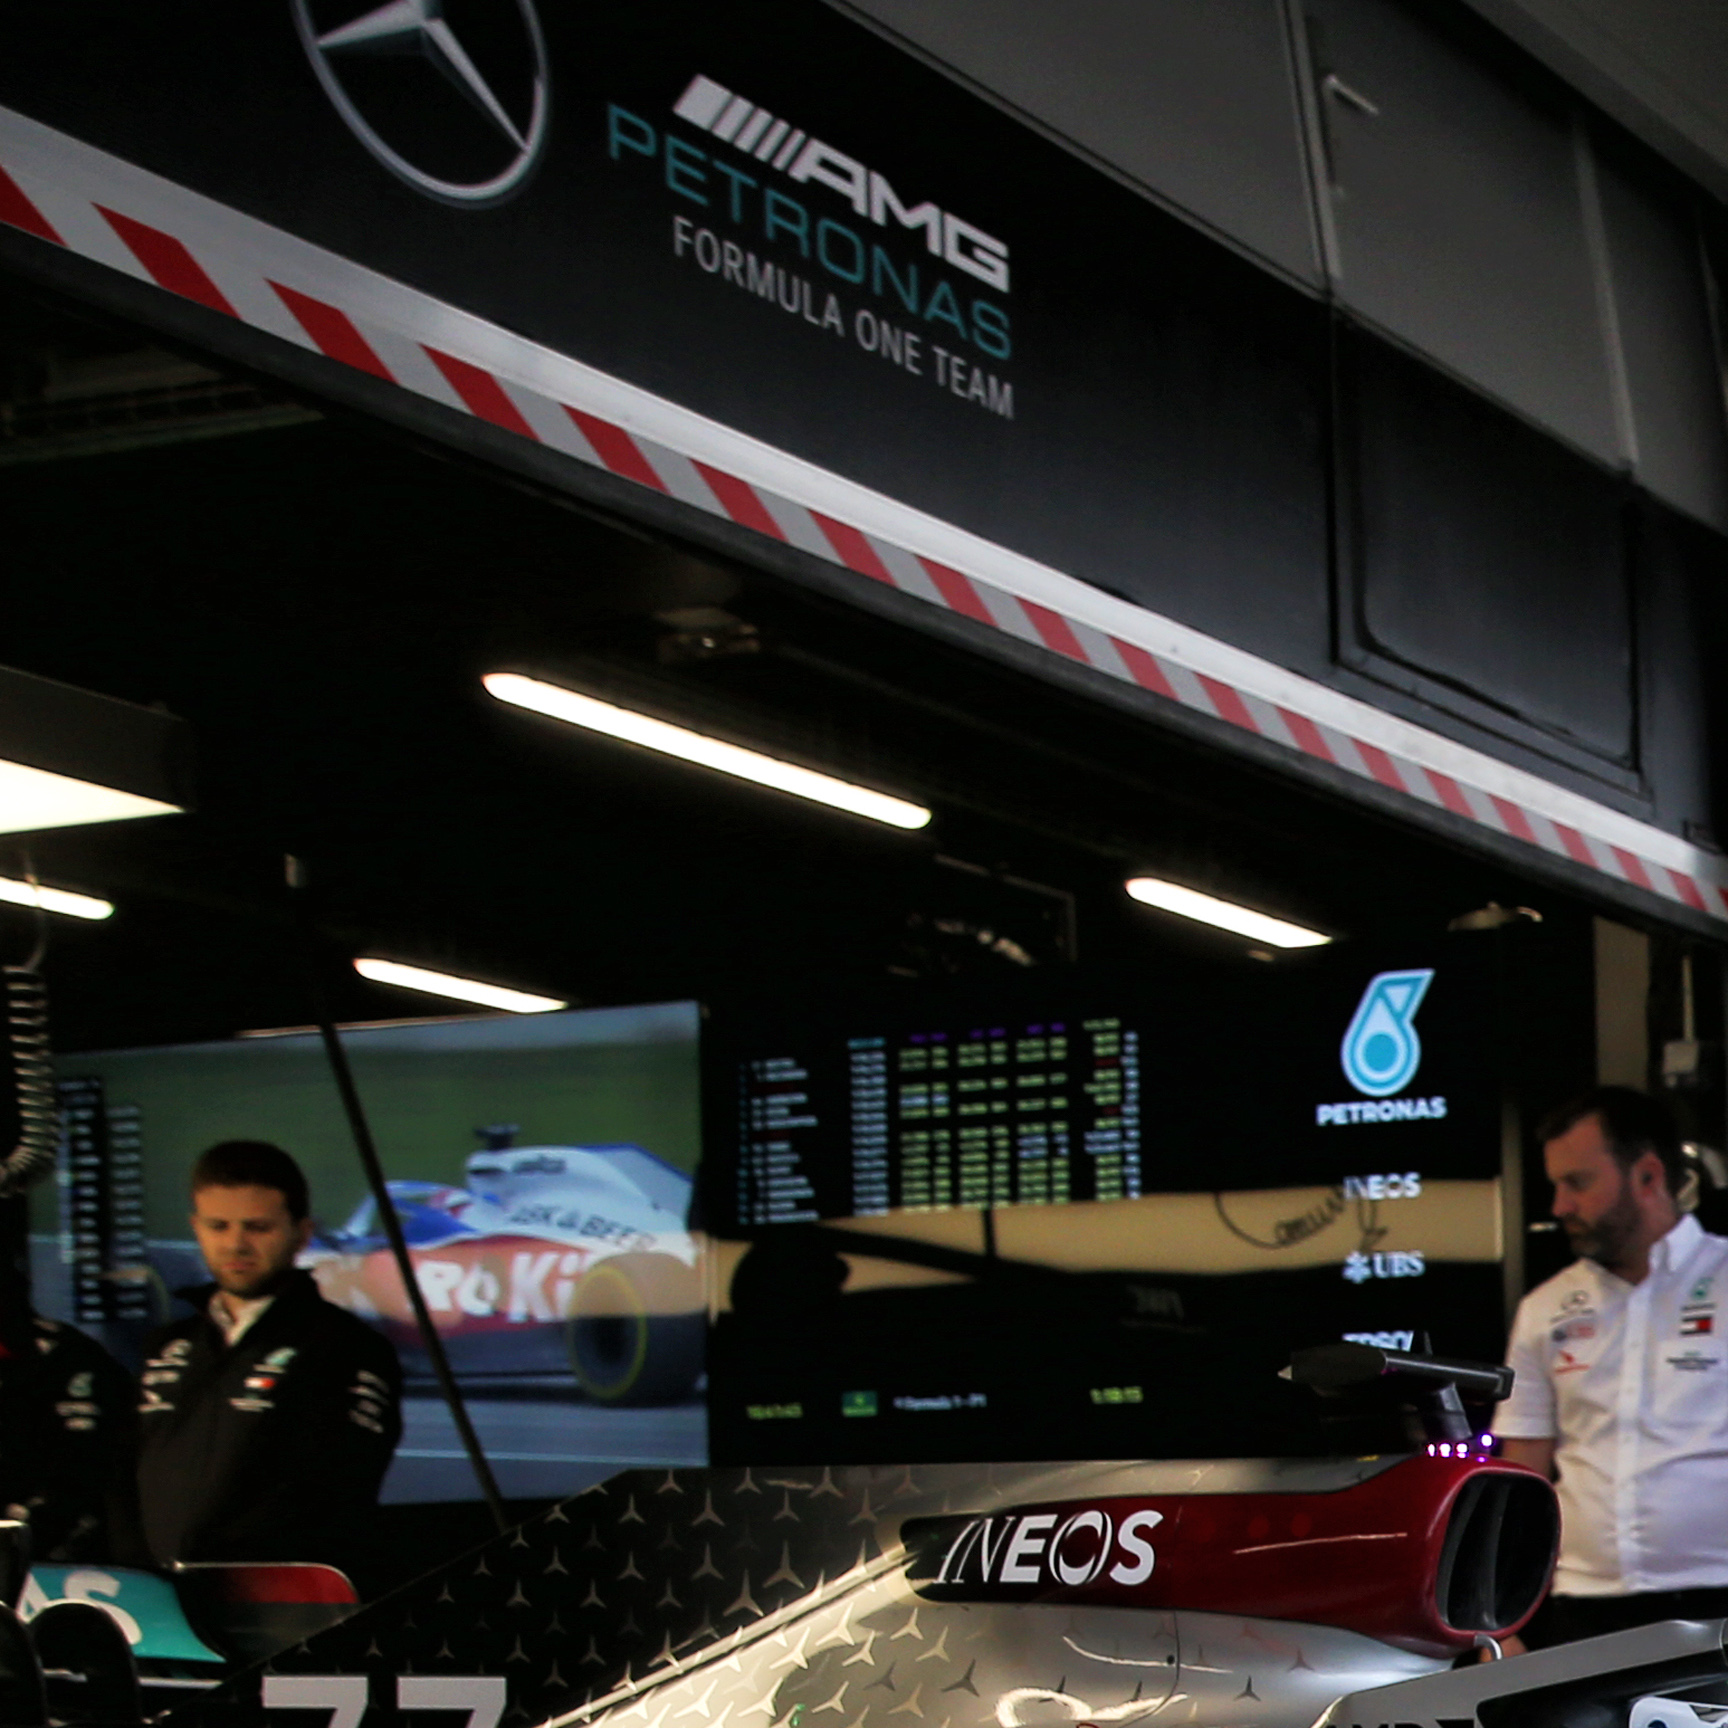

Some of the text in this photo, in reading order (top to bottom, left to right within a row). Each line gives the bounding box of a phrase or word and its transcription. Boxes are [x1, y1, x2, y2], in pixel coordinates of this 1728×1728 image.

[607, 102, 1012, 361] PETRONAS
[672, 214, 1014, 421] FORMULA ONE TEAM
[1316, 1097, 1448, 1126] PETRONAS
[1343, 1172, 1422, 1200] INEOS
[1373, 1251, 1425, 1278] UBS
[932, 1510, 1165, 1586] INEOS
